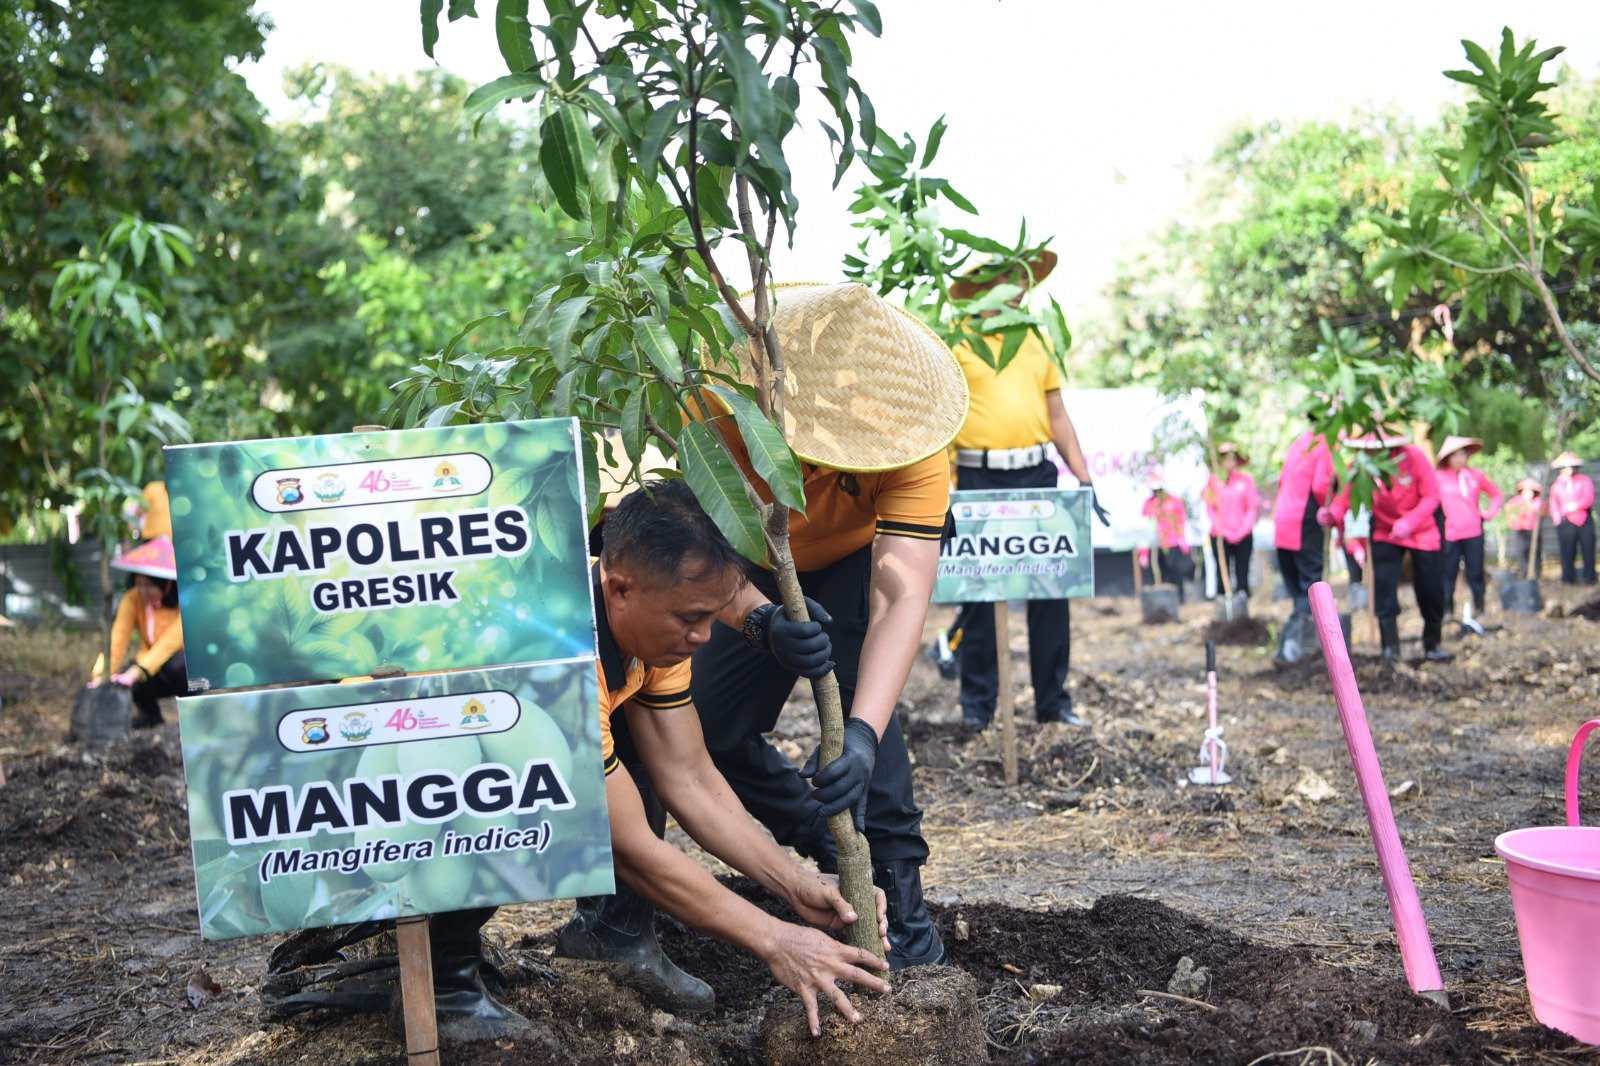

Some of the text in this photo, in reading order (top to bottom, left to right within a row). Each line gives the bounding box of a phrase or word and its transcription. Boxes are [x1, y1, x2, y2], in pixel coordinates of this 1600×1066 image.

[359, 470, 391, 493] 46
[228, 509, 529, 577] KAPOLRES
[313, 571, 458, 612] GRESIK
[384, 708, 418, 732] 46
[228, 763, 569, 840] MANGGA
[260, 822, 552, 881] (Mangifera indica)
